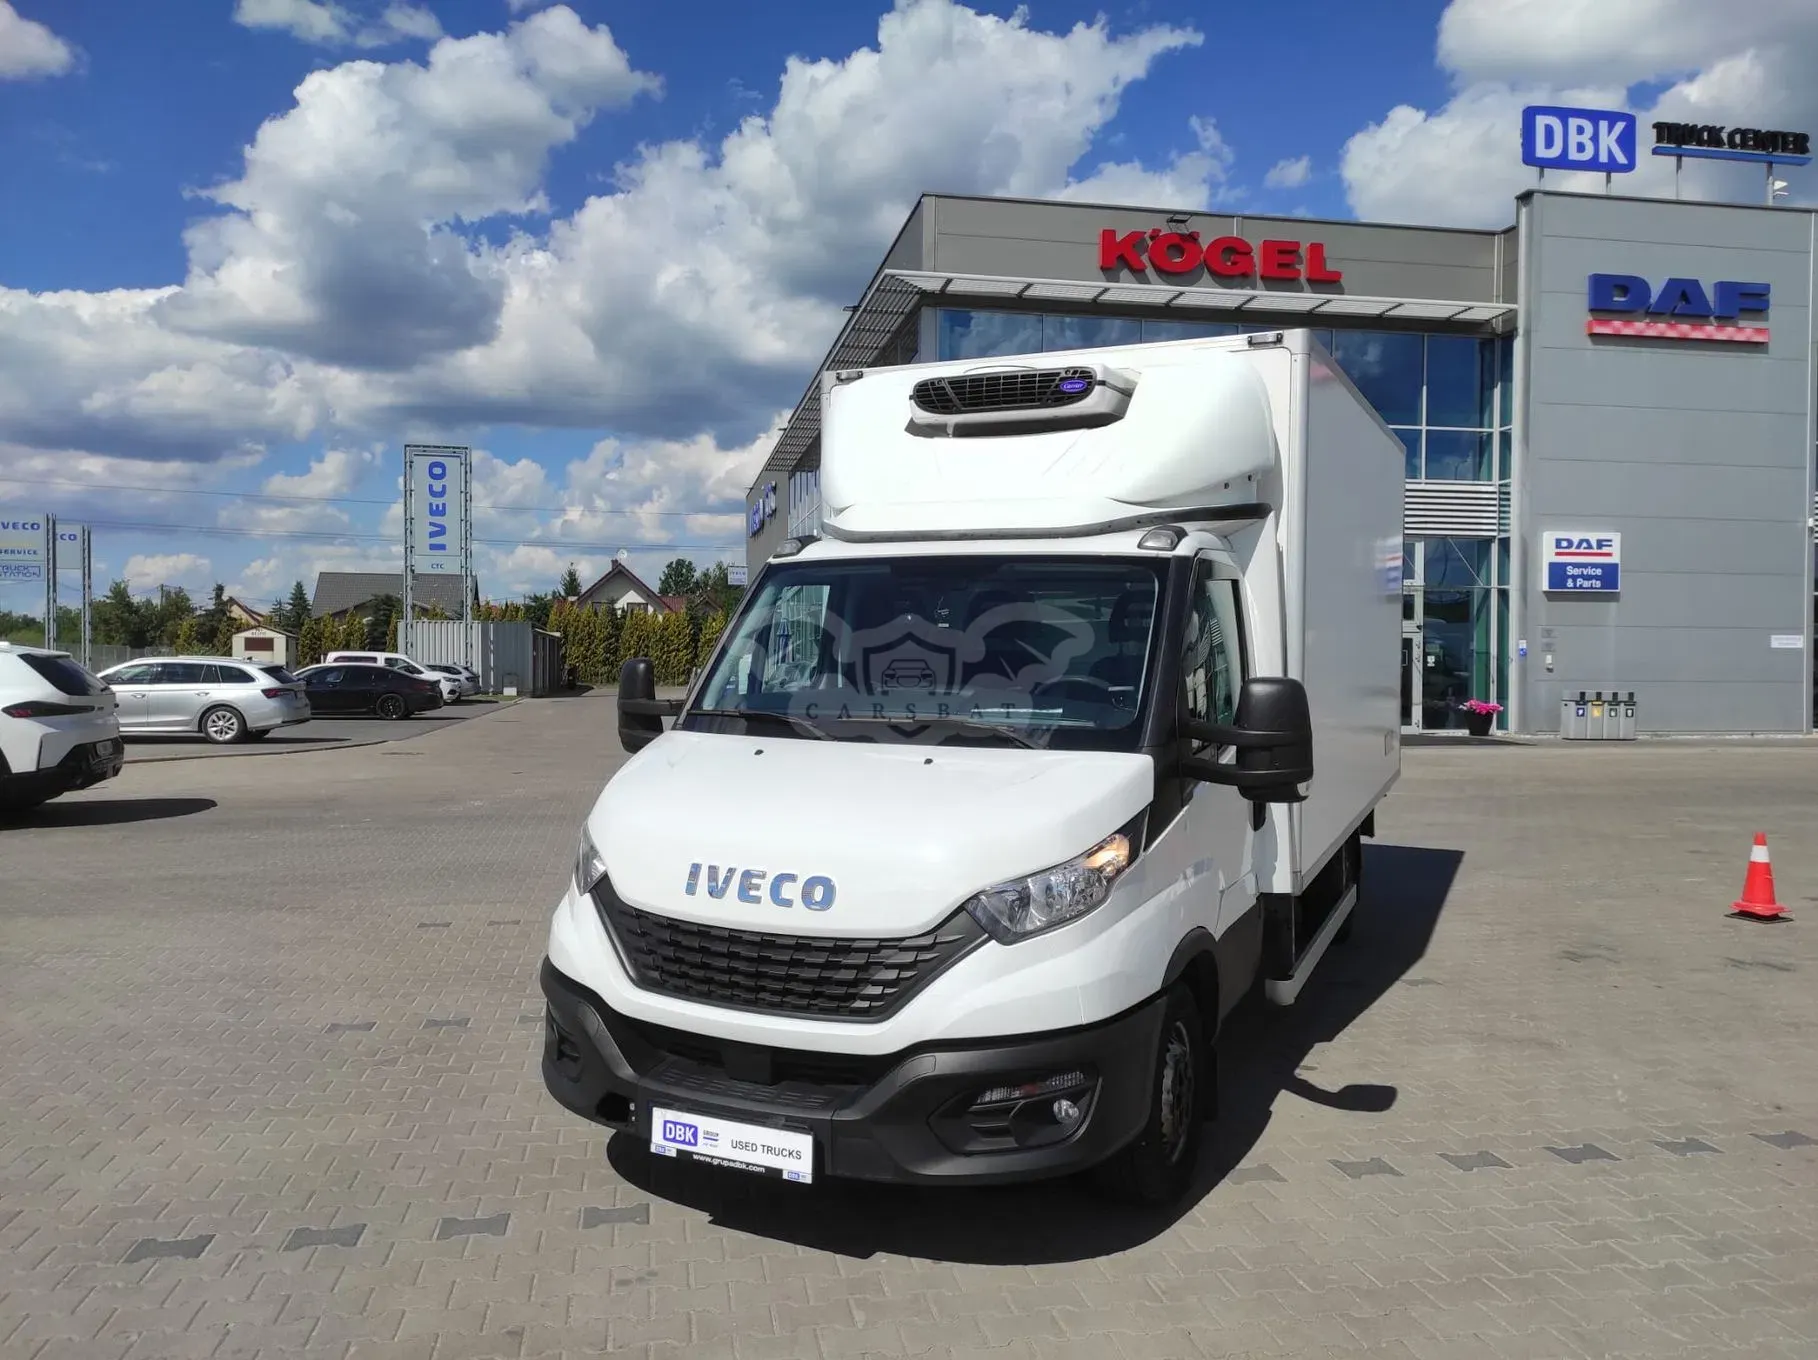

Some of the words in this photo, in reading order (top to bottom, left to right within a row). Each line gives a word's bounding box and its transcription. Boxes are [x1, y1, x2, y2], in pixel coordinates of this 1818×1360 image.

[1535, 115, 1628, 165] DBK
[1652, 122, 1727, 147] TRUCK
[1727, 128, 1810, 154] CENTER
[1098, 228, 1342, 282] KÖGEL
[1588, 273, 1771, 319] DAF
[429, 461, 446, 551] IVECO
[0, 521, 41, 531] VECO
[1555, 538, 1613, 550] DAF
[1566, 566, 1603, 576] Service
[1566, 578, 1574, 588] &
[1576, 578, 1602, 588] Parts
[685, 863, 837, 912] IVECO
[665, 1122, 695, 1144] DBK
[731, 1139, 757, 1152] USED
[760, 1144, 802, 1160] TRUCKS
